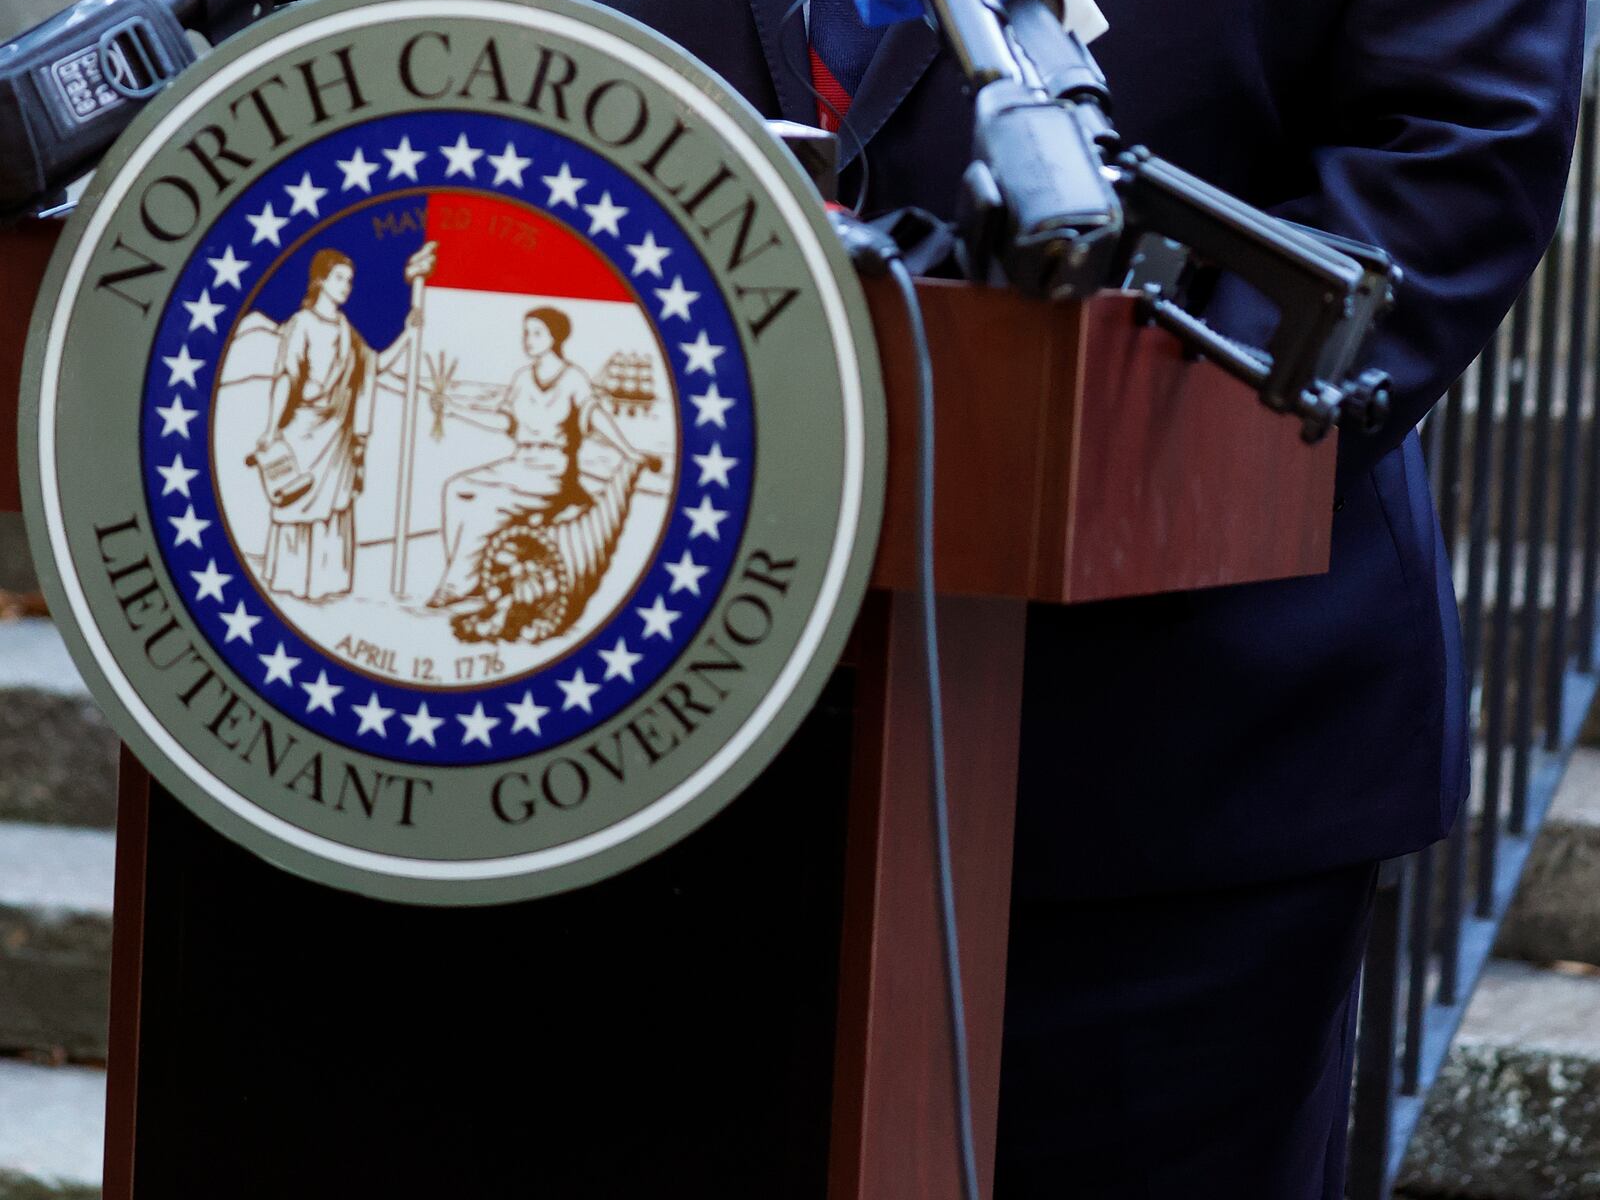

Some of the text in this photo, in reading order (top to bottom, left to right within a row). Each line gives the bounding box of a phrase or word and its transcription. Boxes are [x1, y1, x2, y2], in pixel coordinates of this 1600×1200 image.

[94, 31, 801, 342] NORTH CAROLINA
[372, 208, 428, 240] MAY
[94, 517, 797, 826] LIEUTENANT GOVERNOR
[335, 634, 398, 674] APRIL
[454, 653, 506, 679] 1776
